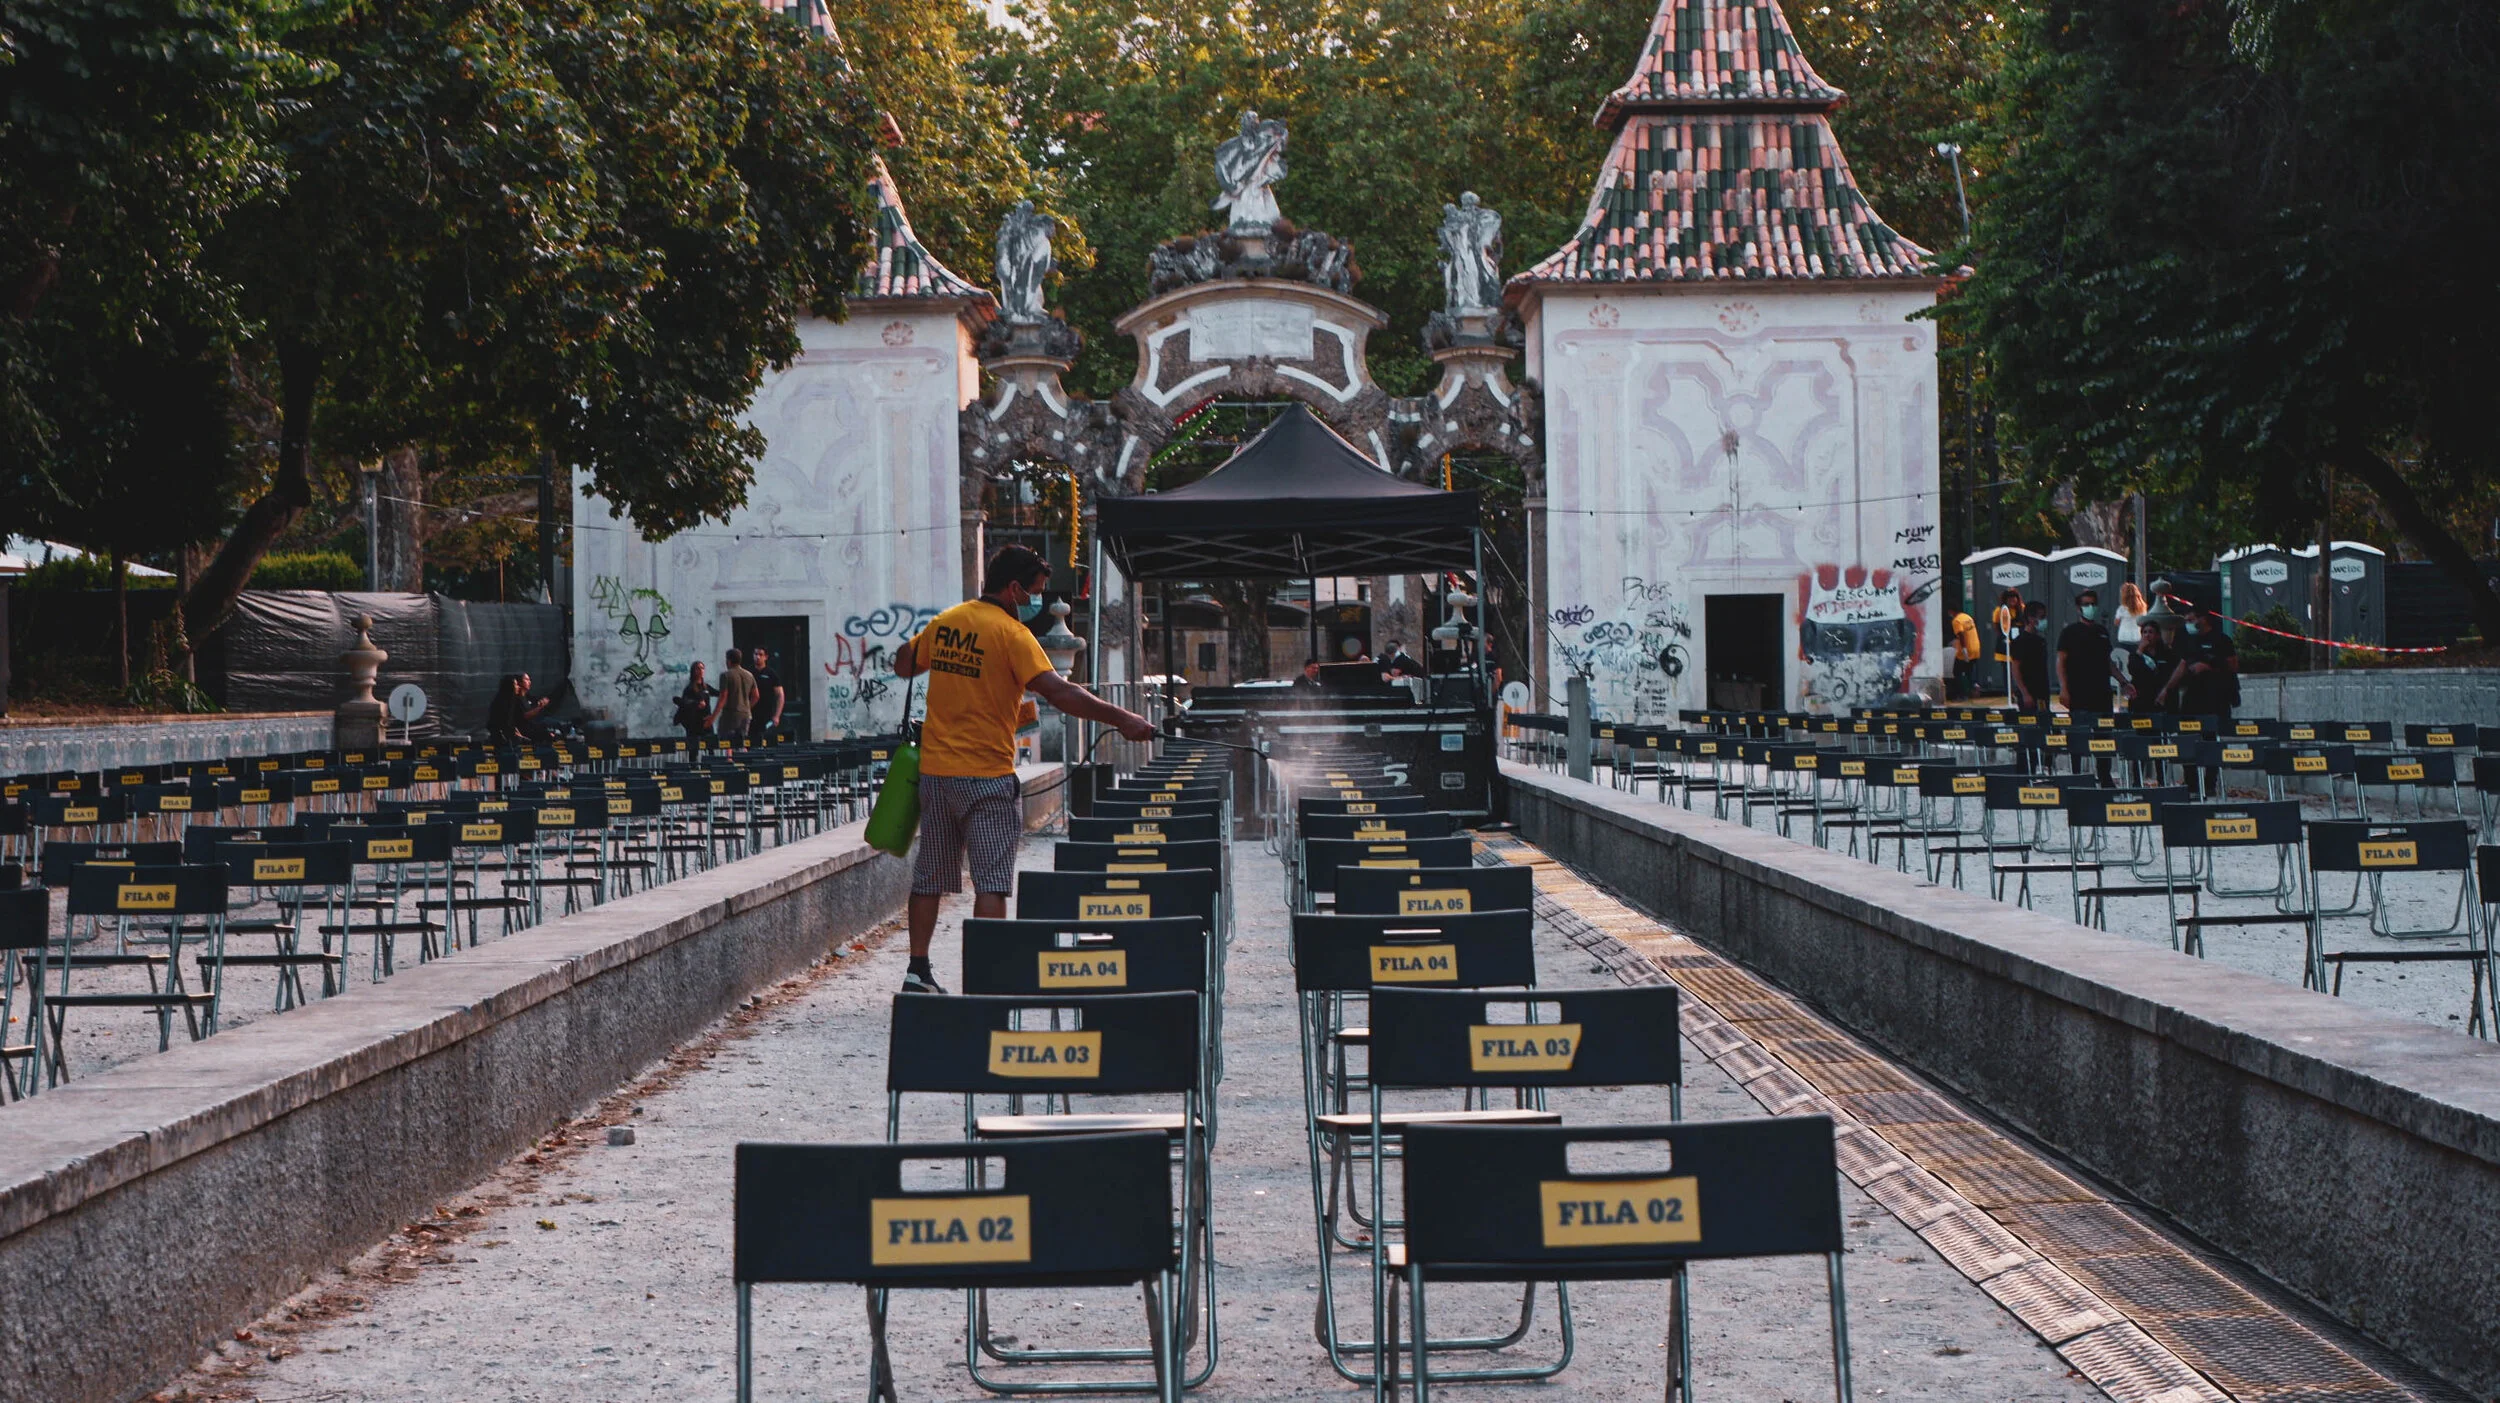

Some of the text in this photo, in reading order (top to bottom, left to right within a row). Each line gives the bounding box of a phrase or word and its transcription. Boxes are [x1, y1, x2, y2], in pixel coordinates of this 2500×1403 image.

[935, 625, 985, 656] RML
[2023, 792, 2043, 800] FILA
[67, 811, 85, 819] FILA
[543, 813, 561, 821] FILA
[1145, 808, 1166, 816] FILA
[2111, 809, 2134, 817] FILA
[466, 829, 486, 837] FILA
[2211, 825, 2252, 834] FILA 07
[372, 844, 408, 853] FILA 08
[2365, 848, 2411, 859] FILA 06
[259, 864, 300, 874] FILA 07
[124, 891, 170, 901] FILA 06
[1086, 903, 1143, 916] FILA 05
[1406, 898, 1464, 911] FILA 05
[1379, 955, 1449, 971] FILA 04
[1047, 961, 1118, 977] FILA 04
[1481, 1038, 1571, 1057] FILA 03
[1001, 1045, 1090, 1063] FILA 03
[1558, 1197, 1684, 1226] FILA 02
[888, 1216, 1014, 1244] FILA 02
